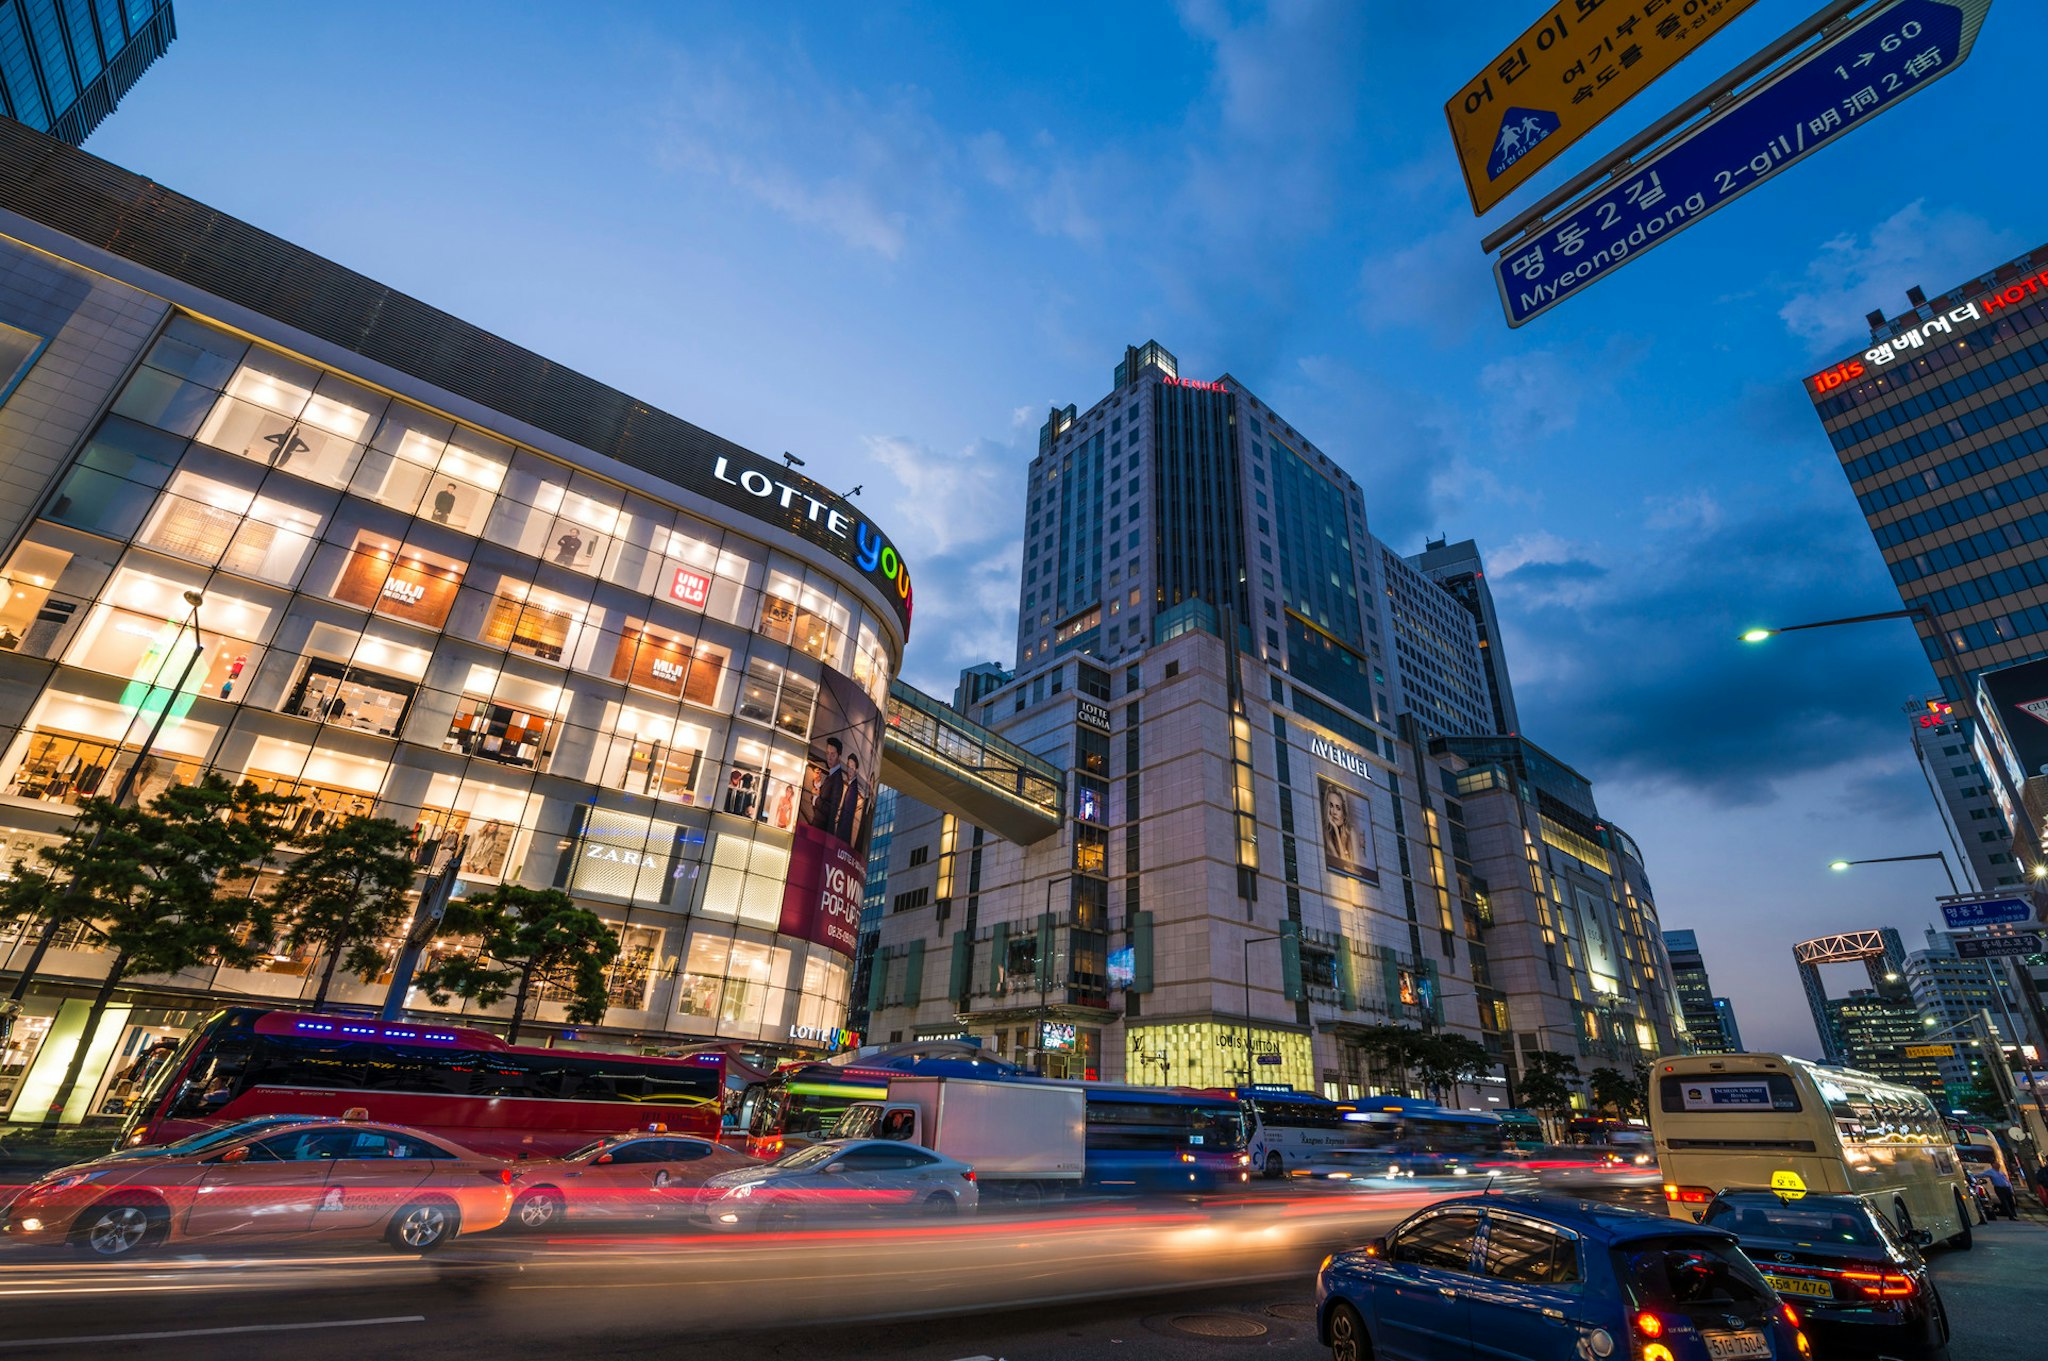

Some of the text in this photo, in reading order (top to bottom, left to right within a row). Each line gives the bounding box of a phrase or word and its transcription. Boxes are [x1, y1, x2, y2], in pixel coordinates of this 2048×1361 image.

[1571, 43, 1644, 105] 속도를
[1511, 170, 1667, 280] 명동2길
[1520, 191, 1705, 311] Myeongdong
[1813, 359, 1865, 394] ibis
[1864, 302, 1981, 366] 앰배서더
[1163, 374, 1229, 393] AVENUEL
[713, 456, 849, 539] LOTTE
[384, 576, 425, 600] MUJI
[677, 572, 704, 590] UNI
[674, 584, 703, 602] QLO
[653, 658, 683, 677] MUJI
[1081, 702, 1108, 719] LOTTE
[1078, 710, 1110, 731] CINEMA
[1919, 713, 1945, 728] SK
[1311, 738, 1372, 780] AVENUEL
[587, 844, 657, 869] ZARA
[825, 863, 845, 894] YG
[1945, 904, 1984, 918] 명동길
[1981, 937, 2034, 950] 유네스코길
[789, 1025, 828, 1042] LOTTE
[1216, 1035, 1242, 1049] LOUIS
[1793, 1280, 1827, 1295] 7476
[1736, 1336, 1764, 1354] 7304
